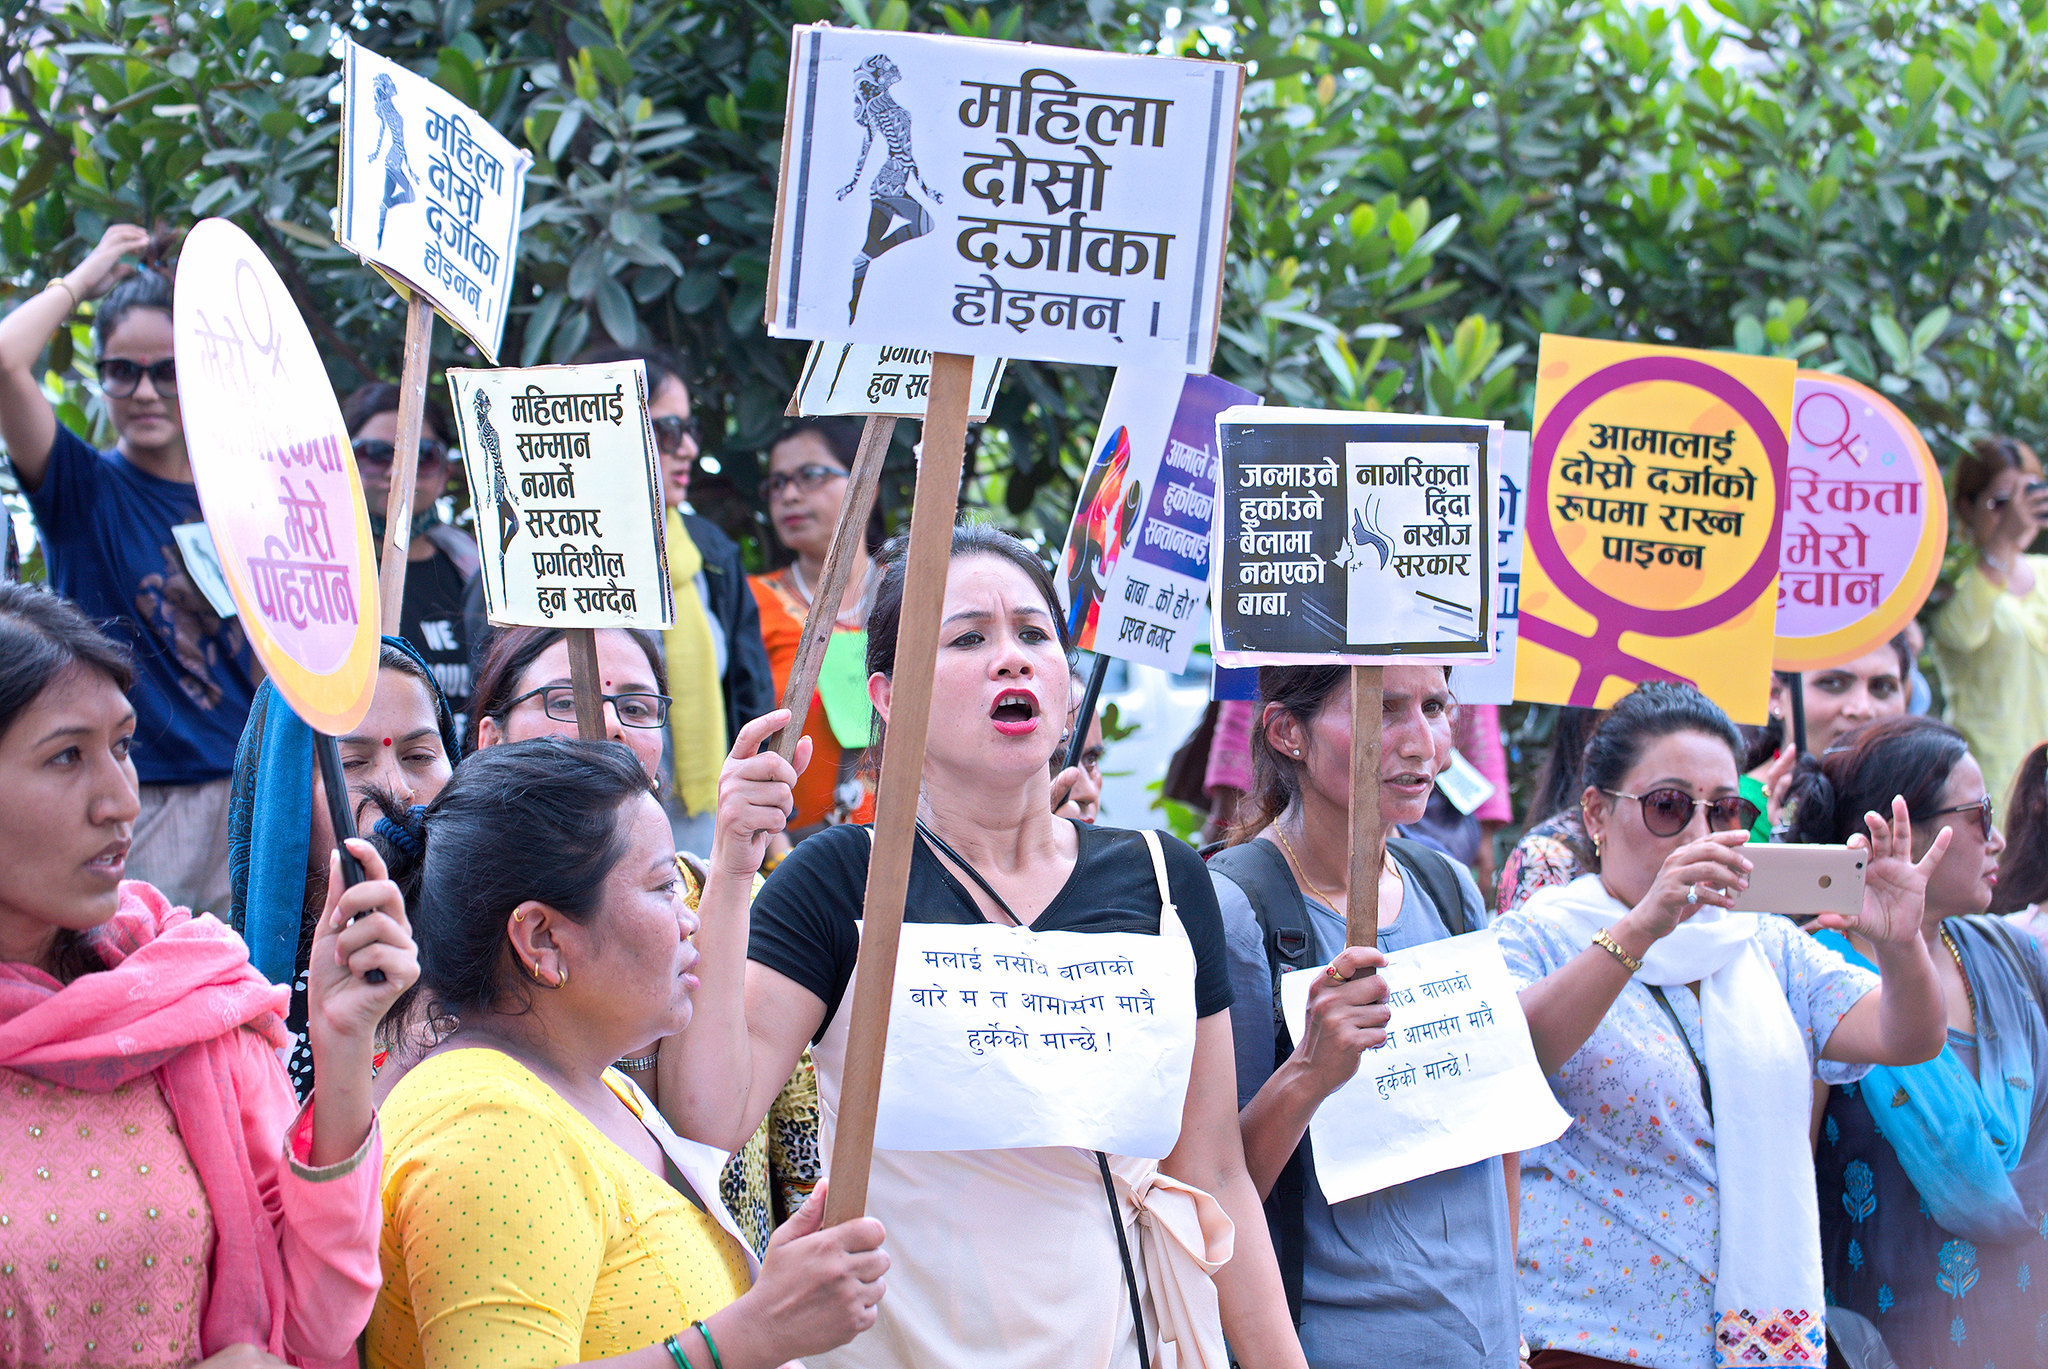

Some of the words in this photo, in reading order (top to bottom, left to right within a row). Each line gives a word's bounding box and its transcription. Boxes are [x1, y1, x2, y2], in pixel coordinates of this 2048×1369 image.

[958, 68, 1175, 148] महिला
[425, 106, 505, 196] महिला
[428, 152, 484, 225] दोस्रो
[962, 138, 1112, 215] दोस्रो
[425, 195, 500, 286] दर्जाका
[956, 211, 1176, 281] दर्जाका
[951, 273, 1126, 343] होइनन्
[511, 384, 625, 426] महिलालाई
[866, 372, 904, 404] हुन
[515, 432, 591, 462] सम्मान
[1165, 439, 1210, 478] आमाले
[1589, 423, 1736, 465] आमालाई
[520, 462, 575, 499] नगर्ने
[1239, 456, 1340, 487] जन्माउने
[1356, 456, 1470, 487] नागरिकता
[1560, 451, 1636, 490] दोस्रो
[1647, 465, 1758, 501] दर्जाको
[1239, 490, 1325, 528] हुर्काउने
[1784, 466, 1922, 516] रिकता
[278, 475, 337, 561] मेरो
[524, 509, 603, 538] सरकार
[1403, 517, 1472, 547] नखोज
[1556, 494, 1649, 528] रूपमा
[1659, 504, 1745, 538] राख्न
[1239, 524, 1313, 555] बेलामा
[1602, 536, 1706, 570] पाइन्न
[1786, 521, 1870, 569] मेरो
[531, 543, 626, 579] प्रगतिशील
[1239, 554, 1327, 585] नभएको
[1393, 554, 1471, 578] सरकार
[248, 535, 360, 630] पहिचान
[536, 586, 567, 618] हुन
[573, 579, 638, 614] सक्दैन
[1777, 571, 1884, 609] चान
[1147, 624, 1176, 653] नगर
[922, 947, 982, 972] मलाई
[960, 990, 979, 1007] म
[990, 991, 1008, 1009] त
[1021, 992, 1105, 1016] आमासंग
